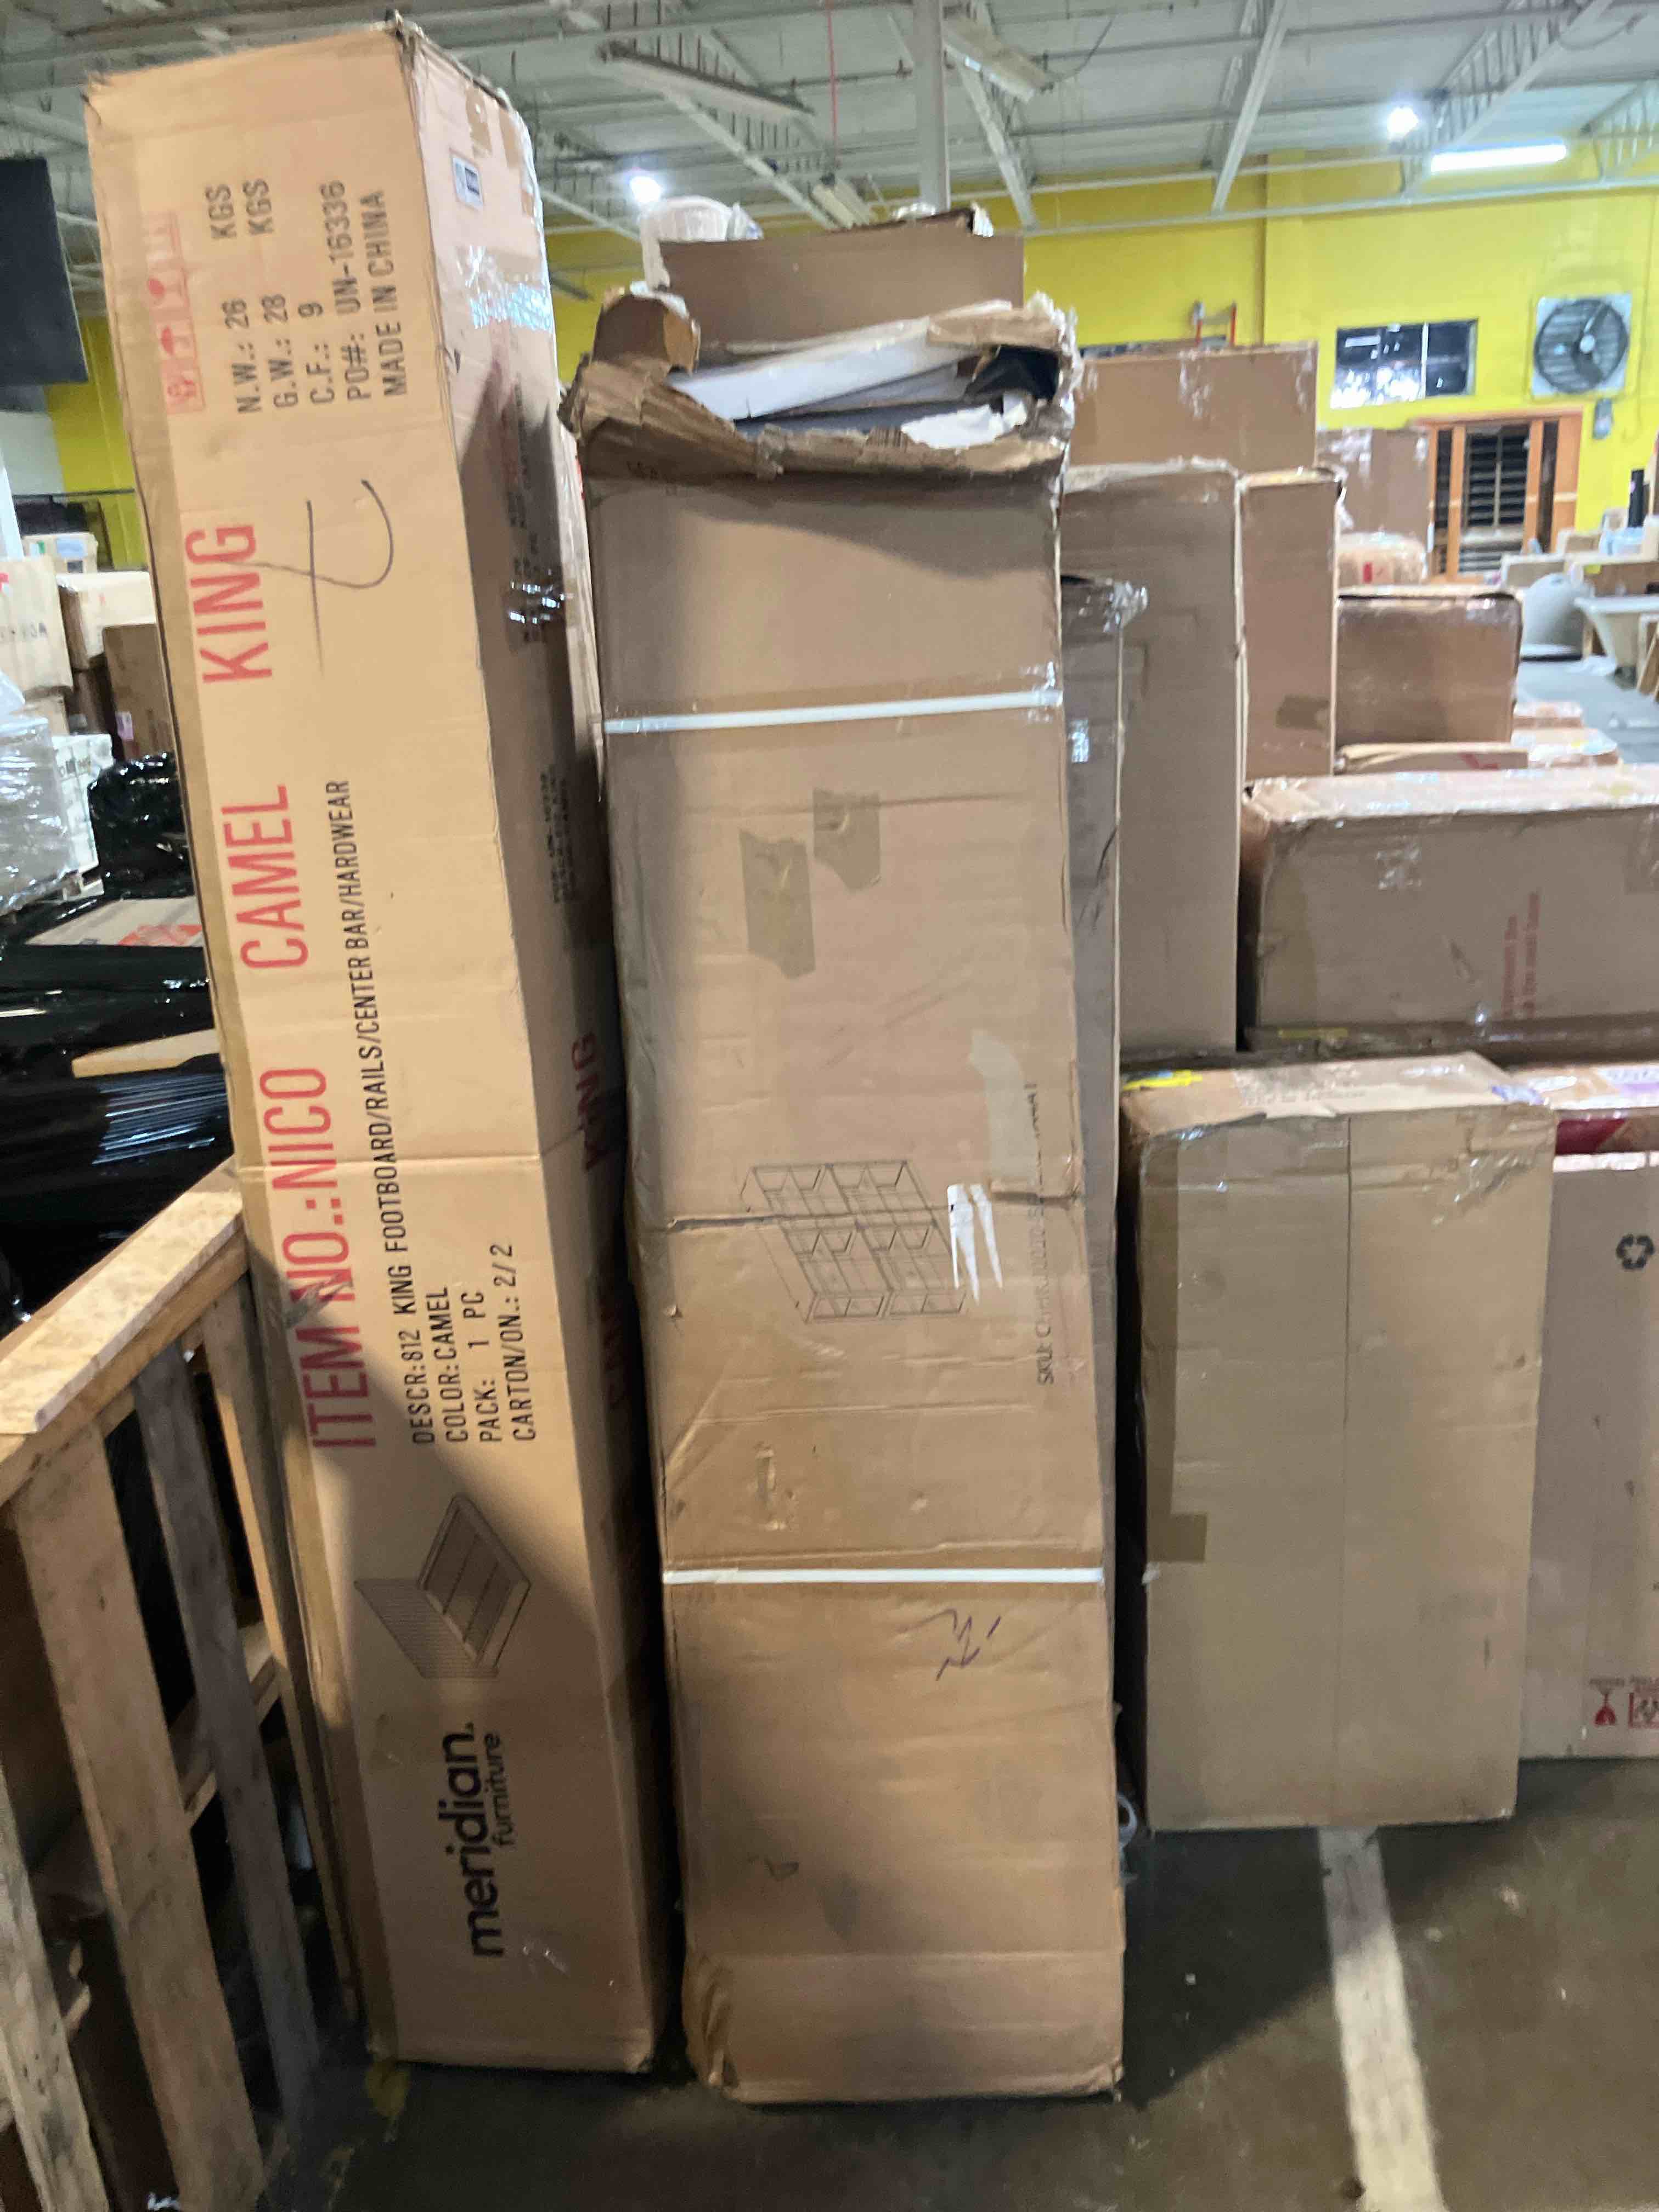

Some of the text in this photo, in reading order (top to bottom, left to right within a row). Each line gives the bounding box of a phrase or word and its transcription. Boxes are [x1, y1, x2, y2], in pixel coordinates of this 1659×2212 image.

[205, 183, 237, 239] KGS
[242, 178, 273, 235] KGS
[319, 179, 361, 315] UN-16336
[222, 298, 249, 329] 26
[261, 294, 289, 324] 28
[297, 301, 324, 318] 9
[360, 190, 407, 397] MADE IN CHINA
[185, 524, 273, 684] KING
[221, 784, 309, 968] CAMEL
[326, 780, 369, 950] BAR/HARDWEAR
[388, 1265, 417, 1314] KING
[490, 1243, 517, 1286] 2/2
[295, 1326, 376, 1447] ITEM
[460, 1291, 503, 1443] PACK: 1 PC
[484, 1733, 516, 1847] furniture
